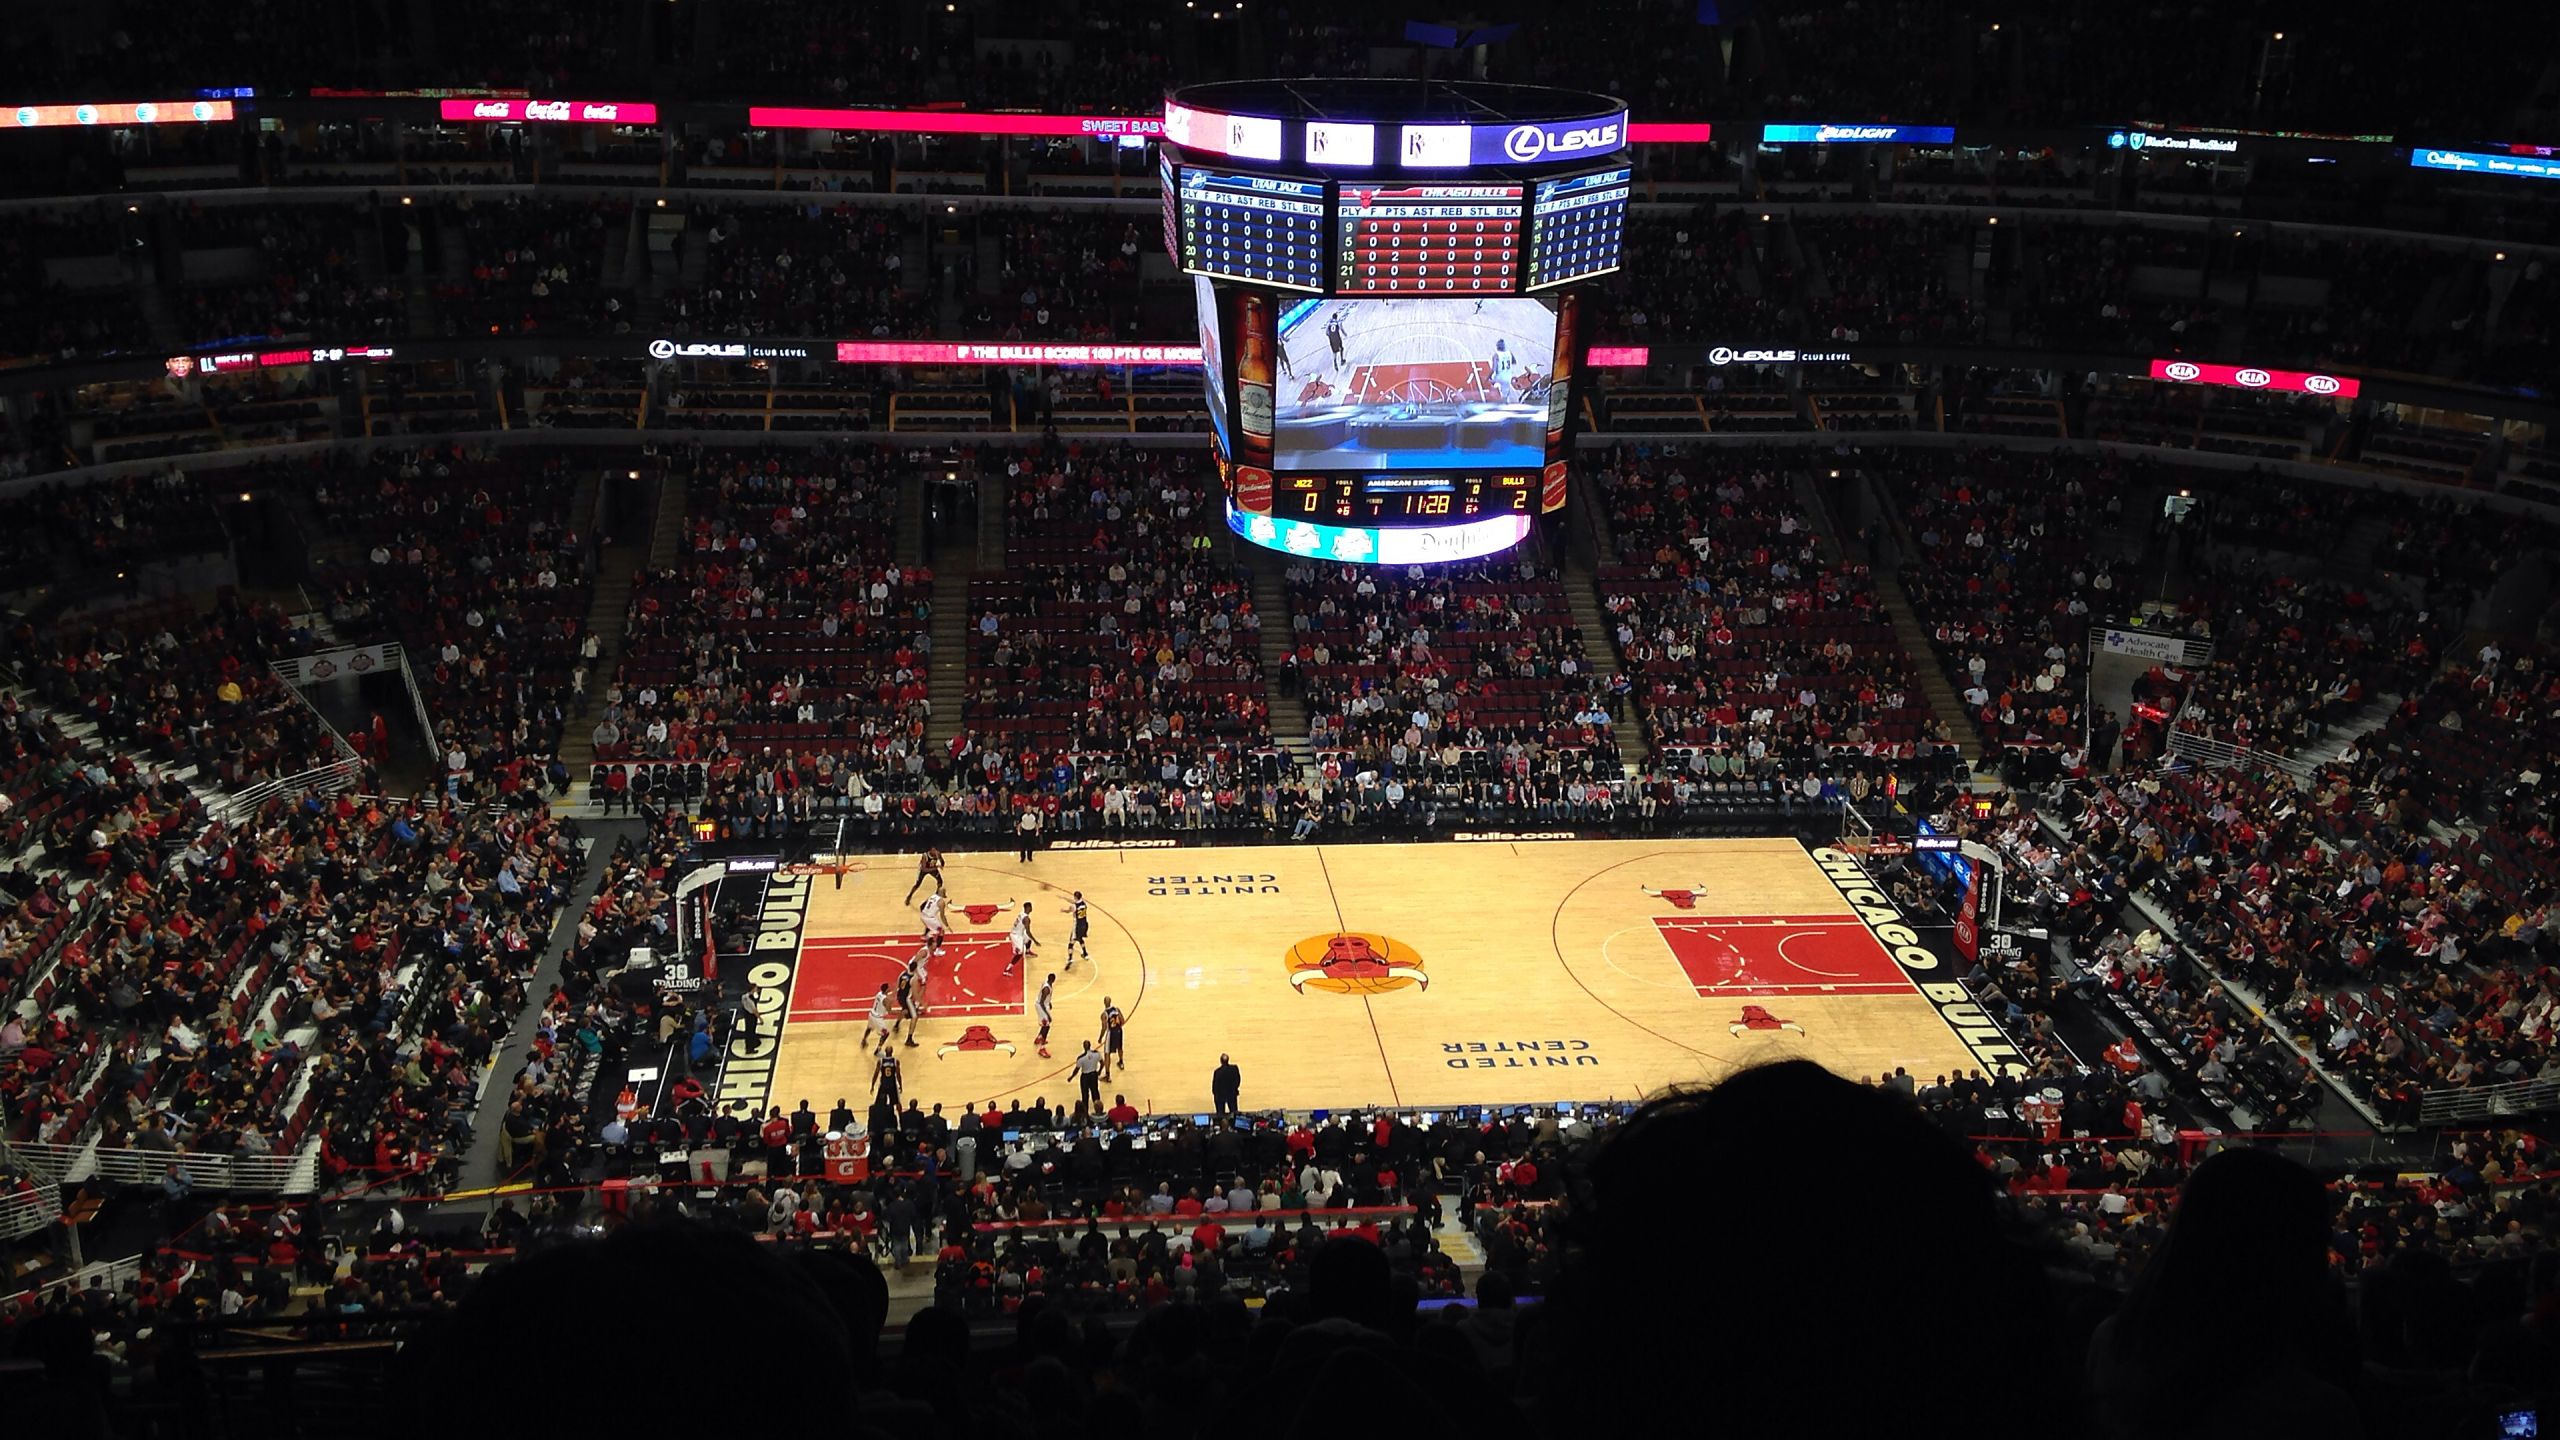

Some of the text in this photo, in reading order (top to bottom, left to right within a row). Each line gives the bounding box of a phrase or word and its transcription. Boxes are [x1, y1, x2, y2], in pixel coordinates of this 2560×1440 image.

[1082, 120, 1166, 132] SWEET BABY
[1546, 124, 1618, 152] LEXUS
[1852, 127, 1897, 139] LIGHT
[2144, 136, 2237, 152] BlueCross BlueShield
[1252, 179, 1302, 192] UTAH JAZZ
[1422, 188, 1508, 197] CHICAGO BULLS
[1182, 190, 1198, 198] PLY
[1216, 194, 1232, 203] PTS
[1237, 196, 1253, 206] AST
[1259, 199, 1276, 208] REB
[1281, 202, 1297, 211] STL
[1303, 204, 1320, 214] BLK
[1184, 203, 1316, 230] 24 0 0 0 0 0 0
[1341, 208, 1518, 216] PLY F PTS AST REB STL BLK
[1185, 218, 1316, 244] 15 0 0 0 0 0 0
[1346, 222, 1353, 232] 9
[1370, 222, 1378, 232] 0
[1393, 222, 1400, 232] 0
[1449, 222, 1457, 232] 0
[1476, 221, 1484, 232] 0
[1504, 221, 1512, 232] 0
[1188, 231, 1316, 259] 0 0 0 0 0 0 0
[1345, 236, 1511, 247] 5 0 0 0 0 0 0
[1342, 250, 1510, 261] 13 0 2 0 0 0 0
[1340, 264, 1509, 276] 21 0 0 0 0 0 0
[1368, 279, 1375, 290] 0
[1390, 279, 1398, 290] 0
[1418, 279, 1426, 290] 0
[1446, 279, 1454, 289] 0
[1472, 279, 1480, 289] 0
[1500, 279, 1508, 289] 0
[676, 344, 806, 357] LEXUS CLUB LEVEL
[958, 346, 970, 359] IF
[972, 346, 998, 359] THE
[1000, 347, 1041, 359] BULLS
[1045, 347, 1089, 360] SCORE
[1115, 348, 1140, 360] PTS
[1143, 348, 1162, 360] OR
[1164, 348, 1202, 360] MORE
[1733, 350, 1796, 361] LEXUS
[260, 350, 310, 366] WEEKDAYS
[1501, 360, 1511, 370] 13
[1294, 480, 1313, 488] JAZZ
[1472, 485, 1480, 494] 0
[1343, 486, 1351, 496] 0
[1304, 492, 1318, 512] 0
[1406, 495, 1450, 514] 11:28
[1513, 490, 1527, 509] 2
[2126, 637, 2169, 649] Advocate
[2125, 647, 2179, 660] Health Care
[1454, 832, 1575, 841] Bulls.com
[1050, 839, 1176, 849] Bulls.com
[729, 860, 776, 870] Bulls.com
[1147, 874, 1276, 885] CENTER
[1148, 885, 1280, 896] UNITED
[1812, 847, 1938, 969] CHICAGO
[1990, 934, 2012, 948] 30
[664, 964, 688, 979] 30
[1440, 1040, 1590, 1053] CENTER
[1446, 1055, 1599, 1069] UNITED
[885, 1067, 892, 1078] 6
[839, 1162, 854, 1176] G
